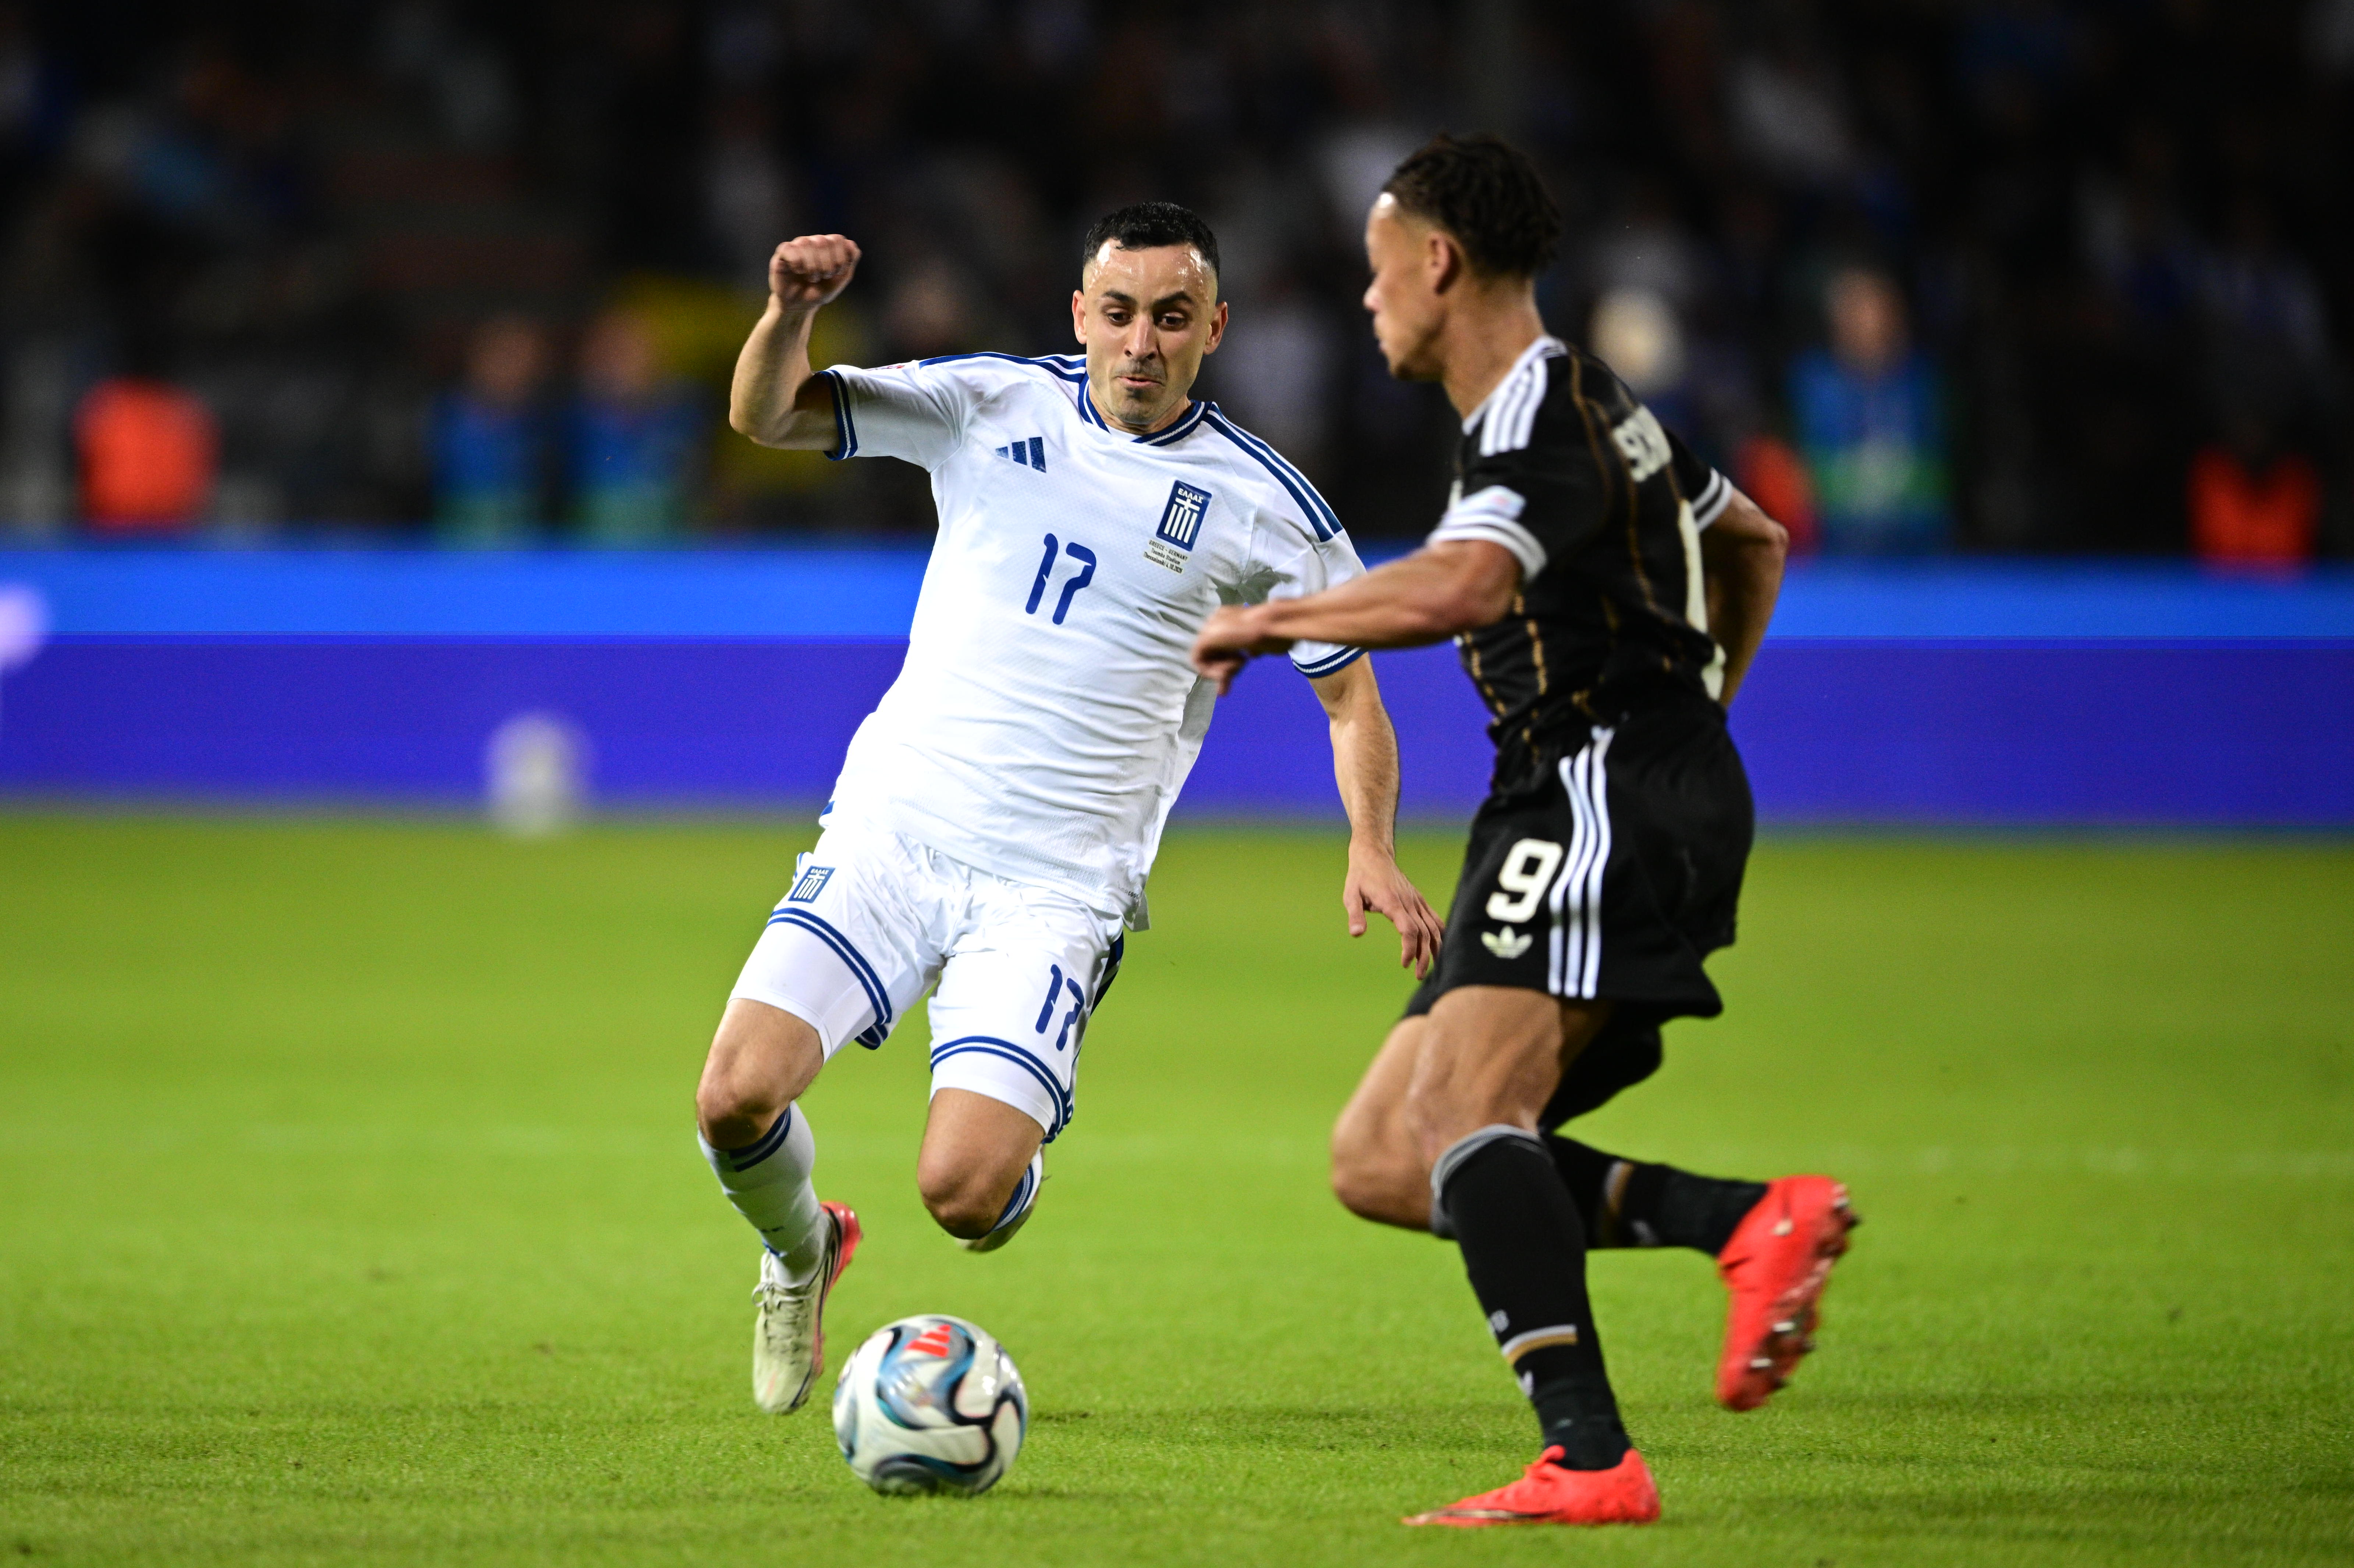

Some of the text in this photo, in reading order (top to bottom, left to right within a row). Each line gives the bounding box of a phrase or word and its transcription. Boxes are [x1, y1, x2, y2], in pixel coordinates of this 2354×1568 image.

[1178, 488, 1204, 504] ΕΛΛΑΣ
[1025, 533, 1096, 625] 17
[1485, 838, 1563, 923] 9
[1035, 964, 1084, 1051] 17
